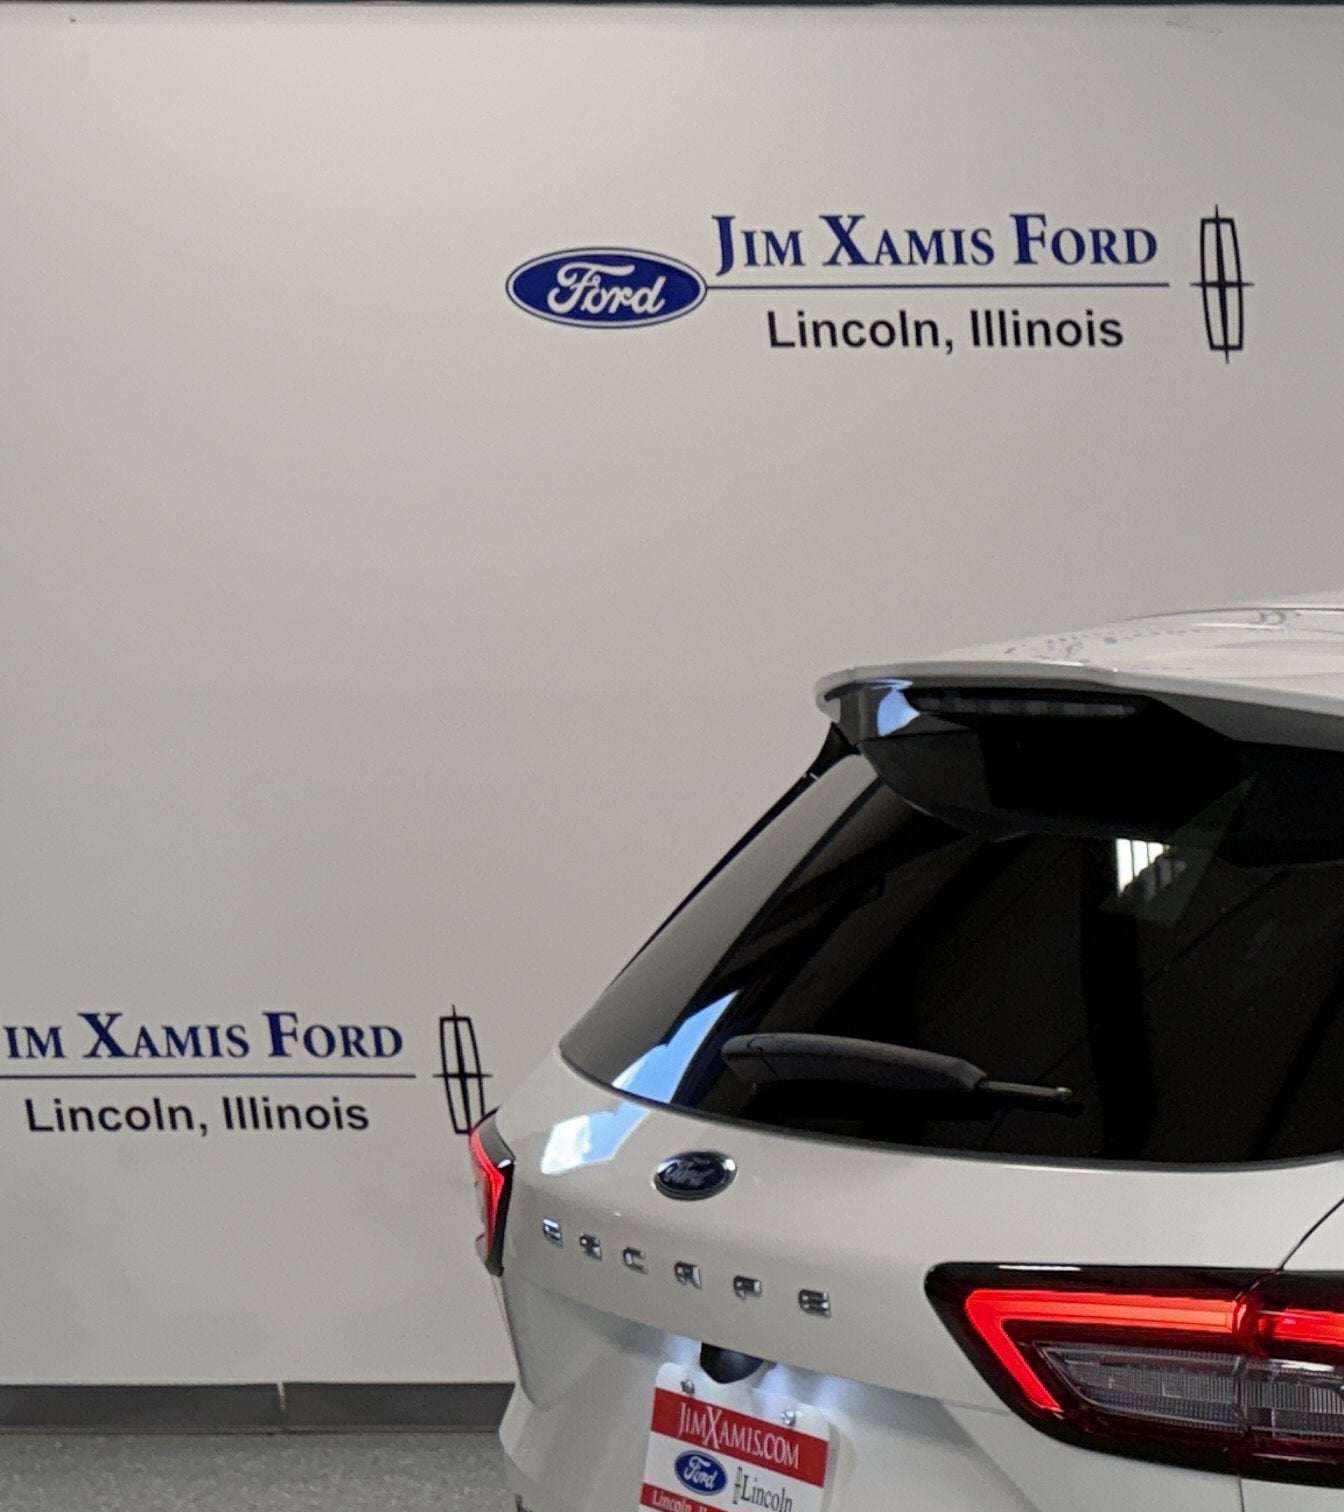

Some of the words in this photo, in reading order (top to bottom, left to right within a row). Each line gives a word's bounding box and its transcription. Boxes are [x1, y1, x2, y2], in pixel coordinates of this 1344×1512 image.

[711, 214, 804, 277] JIM
[818, 214, 996, 266] XAMIS
[1010, 213, 1158, 265] FORD
[546, 260, 667, 316] Ford
[767, 309, 955, 355] Lincoln,
[970, 309, 1124, 348] Illinois
[77, 1011, 251, 1059] XAMIS
[262, 1011, 404, 1058] FORD
[25, 1097, 209, 1137] Lincoln,
[222, 1096, 370, 1131] Illinois
